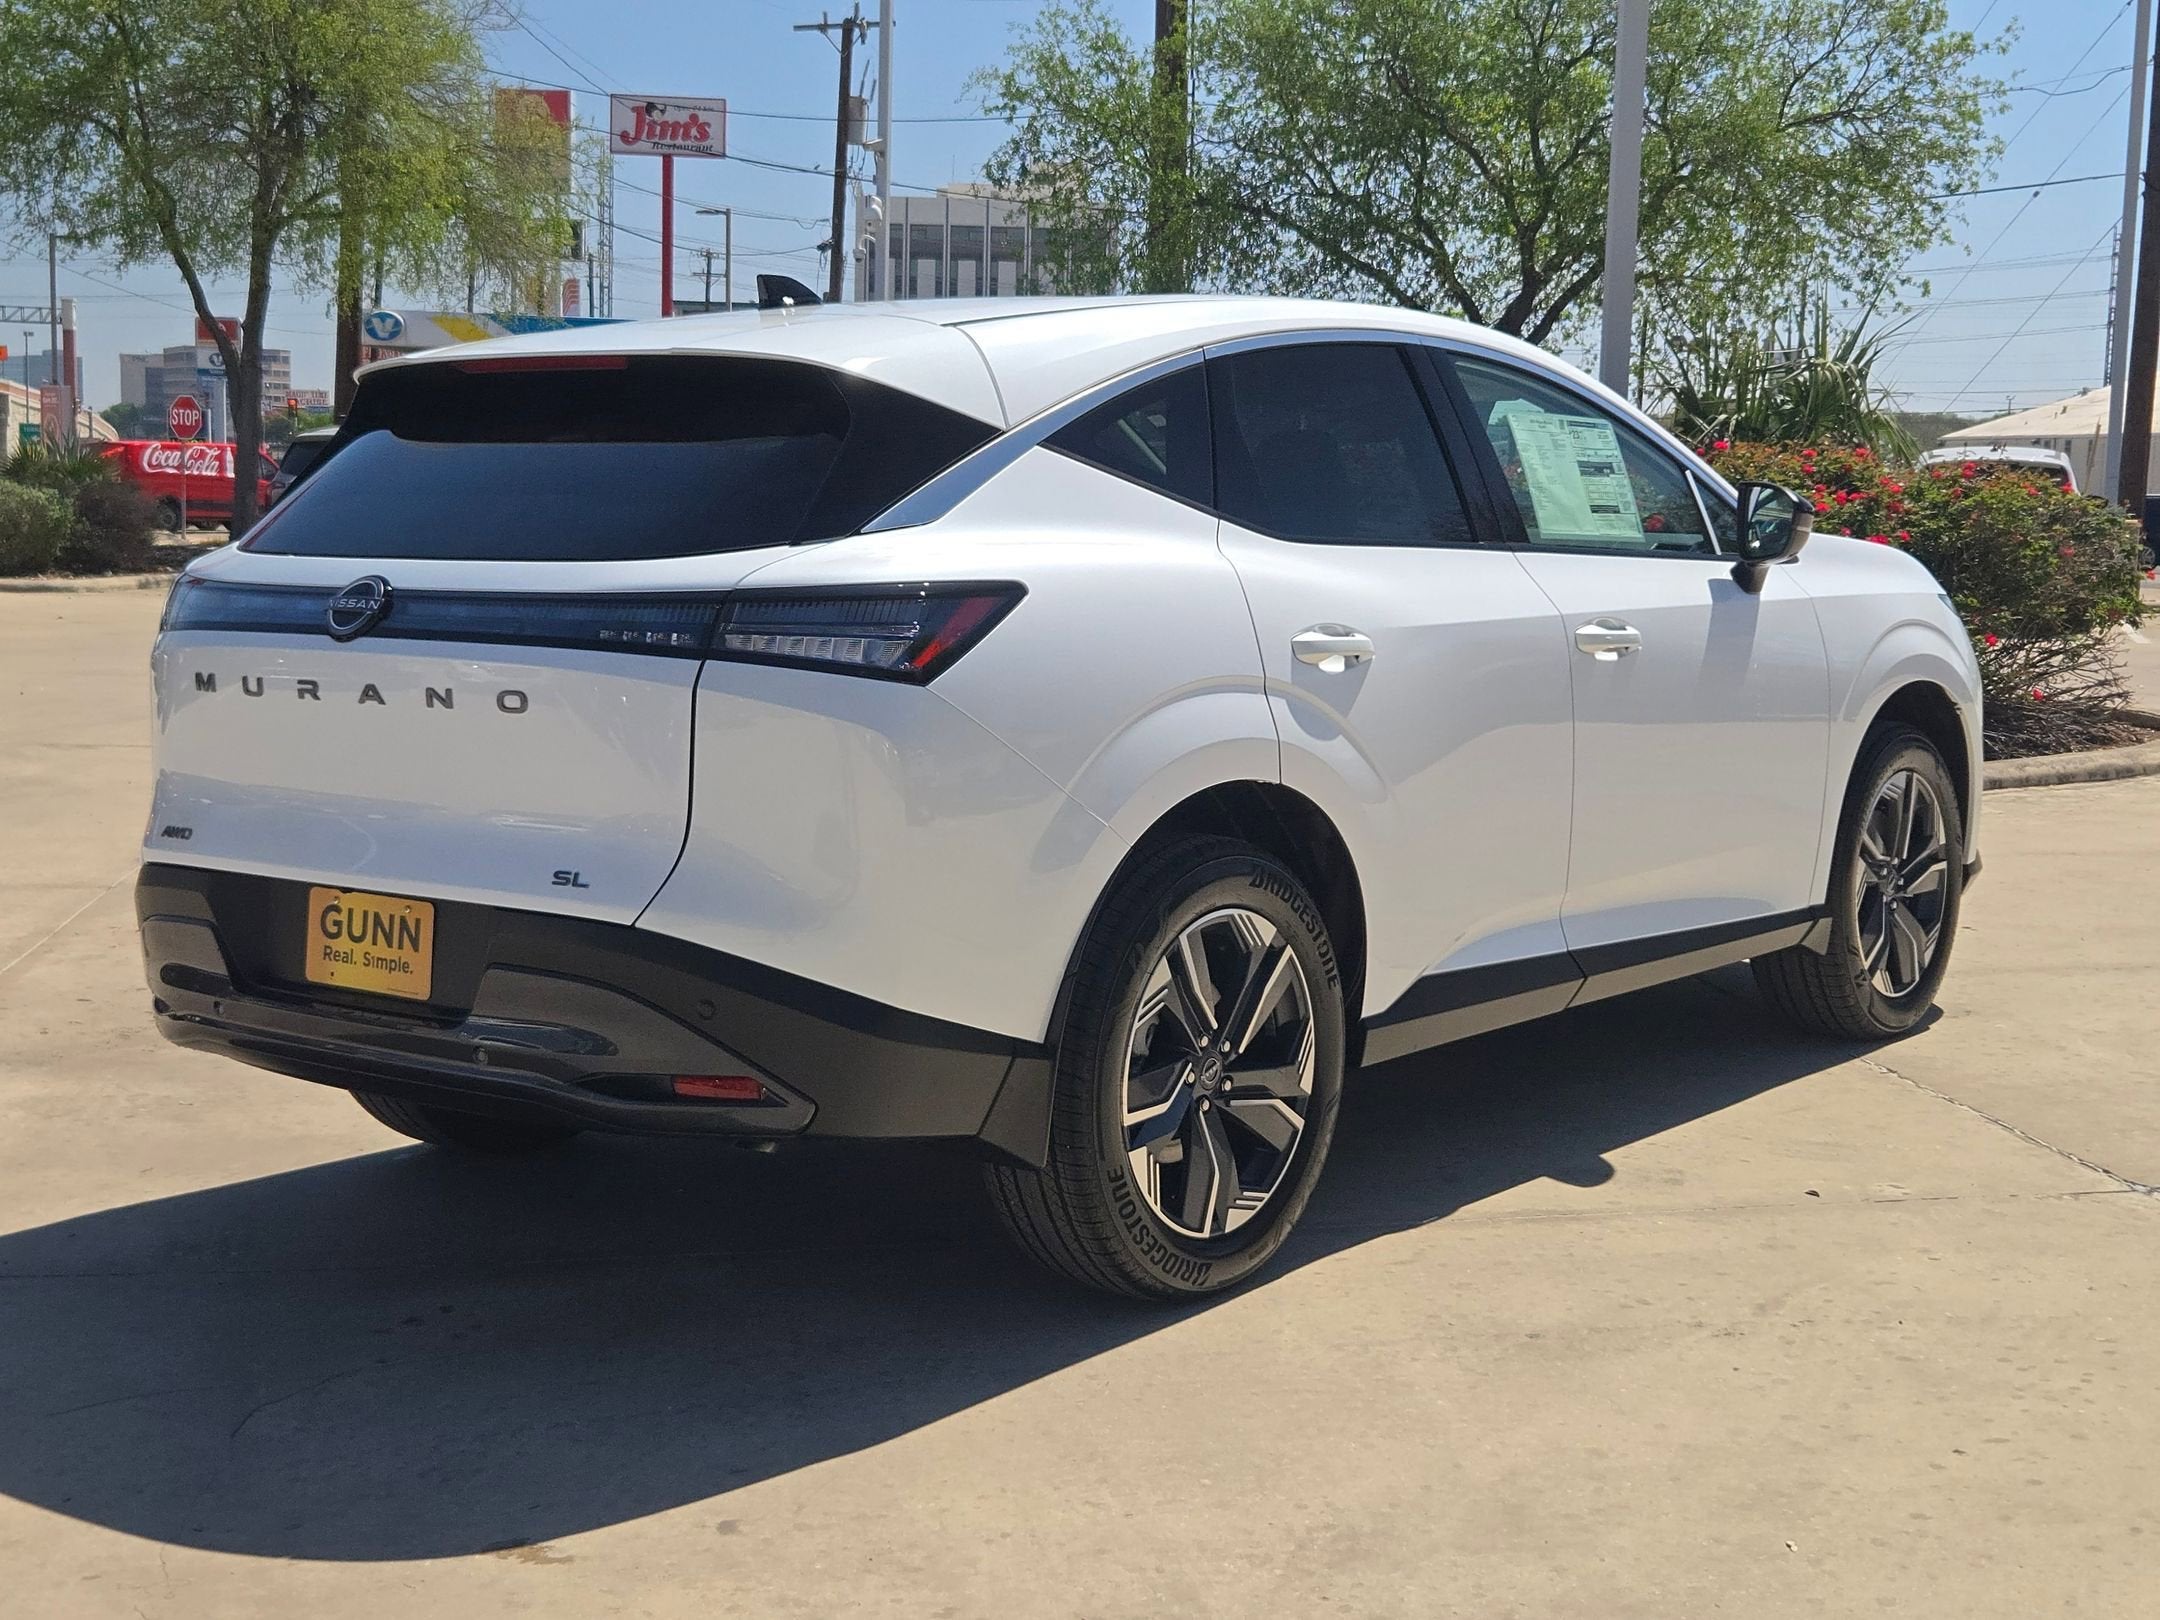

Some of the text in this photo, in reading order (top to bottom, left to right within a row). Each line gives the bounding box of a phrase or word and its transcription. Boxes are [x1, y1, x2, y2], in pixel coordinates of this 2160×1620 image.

[620, 104, 712, 146] Jim's
[171, 408, 200, 426] STOP
[329, 598, 381, 609] NISSAN
[194, 671, 529, 714] MURANO
[161, 825, 193, 840] AWD
[551, 870, 590, 889] SL
[320, 903, 422, 953] GUNN
[323, 945, 414, 975] Real. Simple.
[1106, 1164, 1214, 1287] BRIDGESTONE
